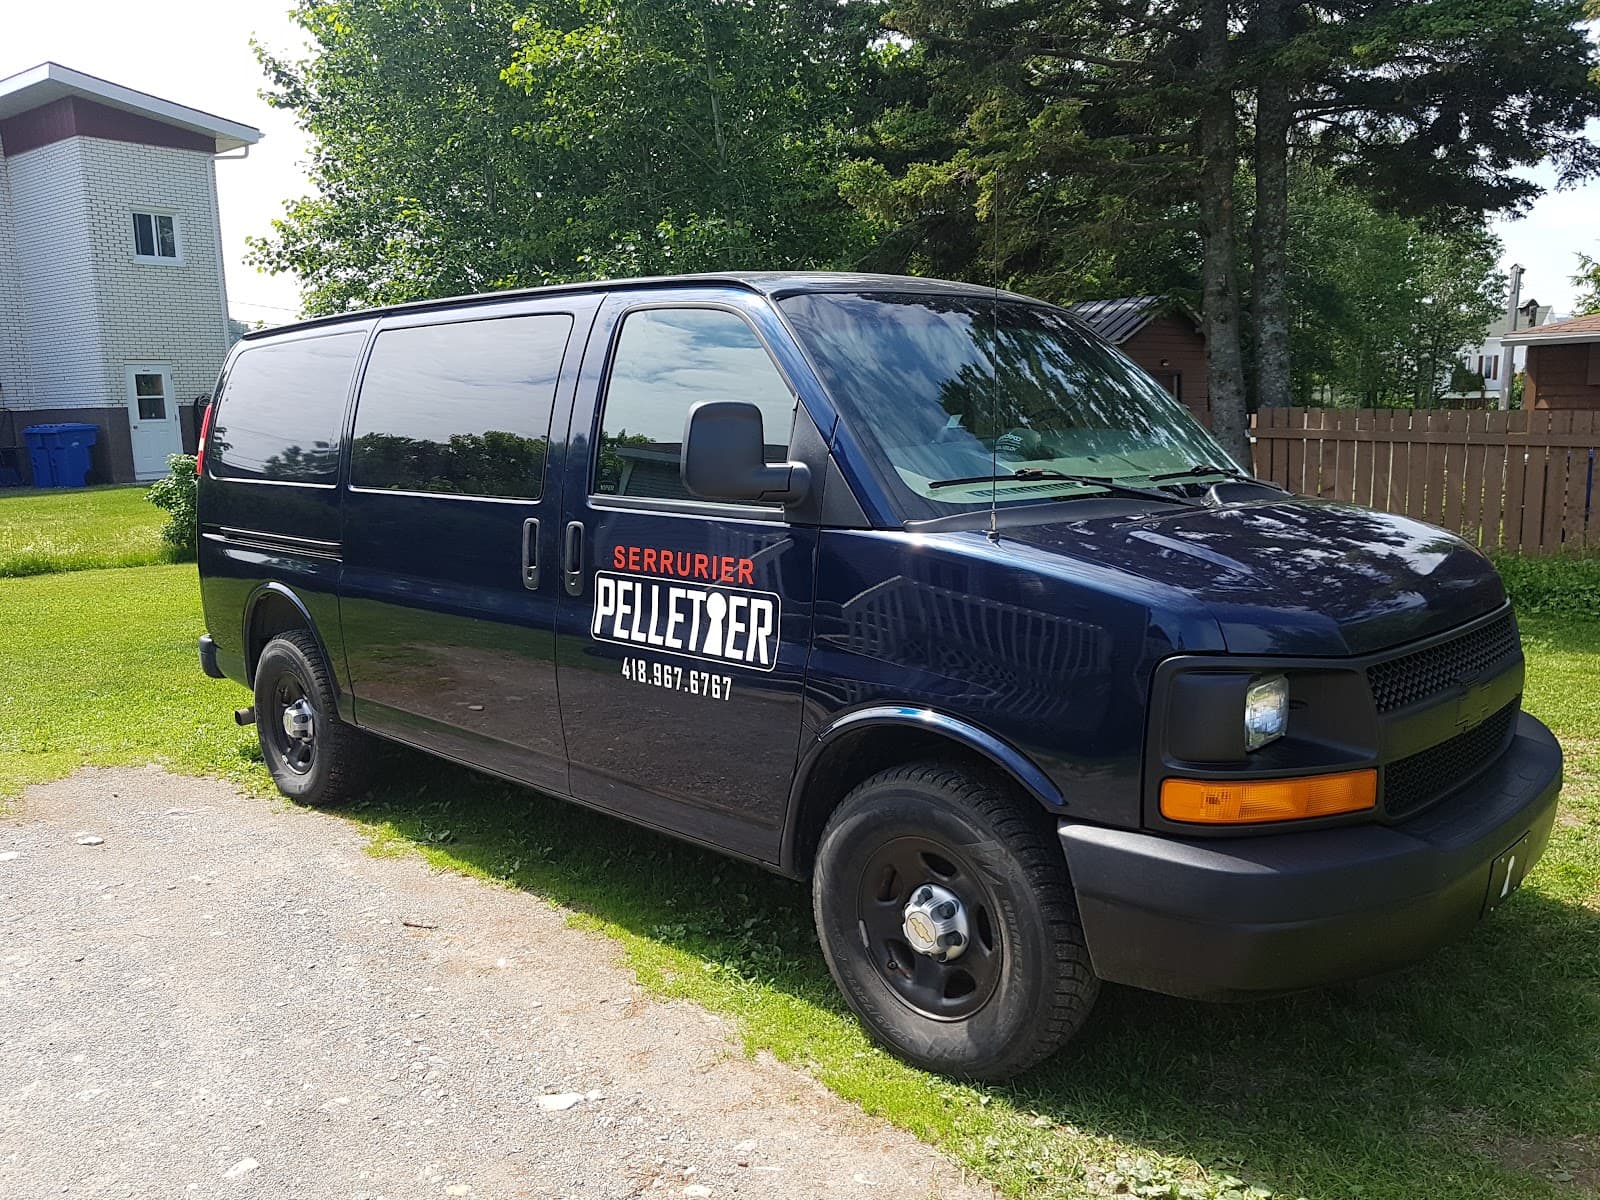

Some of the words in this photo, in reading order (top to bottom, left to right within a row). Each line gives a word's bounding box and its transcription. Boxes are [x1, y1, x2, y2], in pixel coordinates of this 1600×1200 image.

[613, 545, 754, 585] SERRURIER
[594, 577, 773, 665] PELLETIER
[621, 656, 733, 701] 418.967.6767
